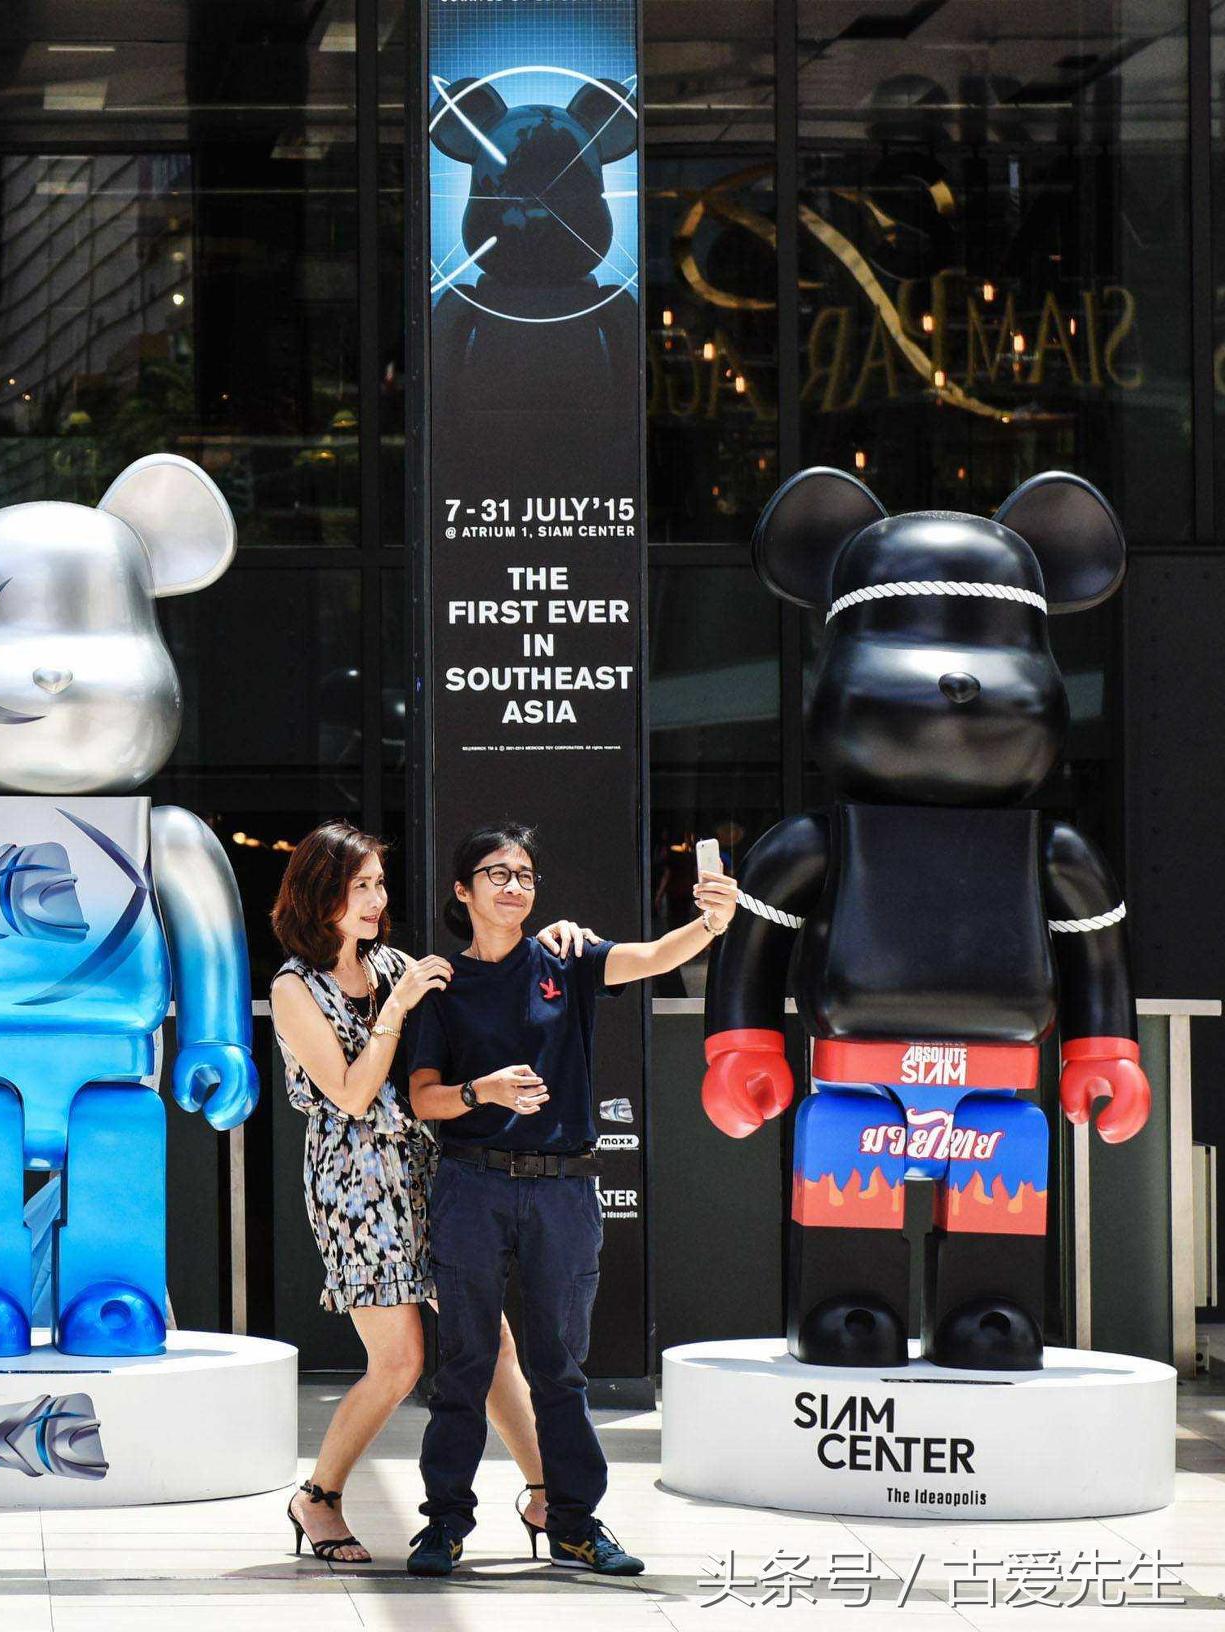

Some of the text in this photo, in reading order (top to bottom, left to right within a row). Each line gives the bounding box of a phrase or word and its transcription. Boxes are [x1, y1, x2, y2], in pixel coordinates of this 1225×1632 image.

[445, 527, 457, 539] @
[462, 526, 516, 538] ATRIUM
[538, 526, 573, 537] SIAM
[579, 525, 635, 537] CENTER
[507, 567, 568, 591] THE
[448, 600, 630, 625] FIRST EVER
[523, 633, 554, 657] IN
[445, 666, 634, 691] SOUTHEAST
[502, 700, 577, 724] ASIA
[901, 1045, 968, 1064] ABSOLUTE
[900, 1060, 967, 1086] SIAM
[601, 1137, 634, 1145] maxx
[861, 1108, 1002, 1160] มวยไทย
[794, 1392, 895, 1433] SIAM
[817, 1433, 975, 1474] CENTER
[887, 1487, 987, 1507] The Ideaopolis
